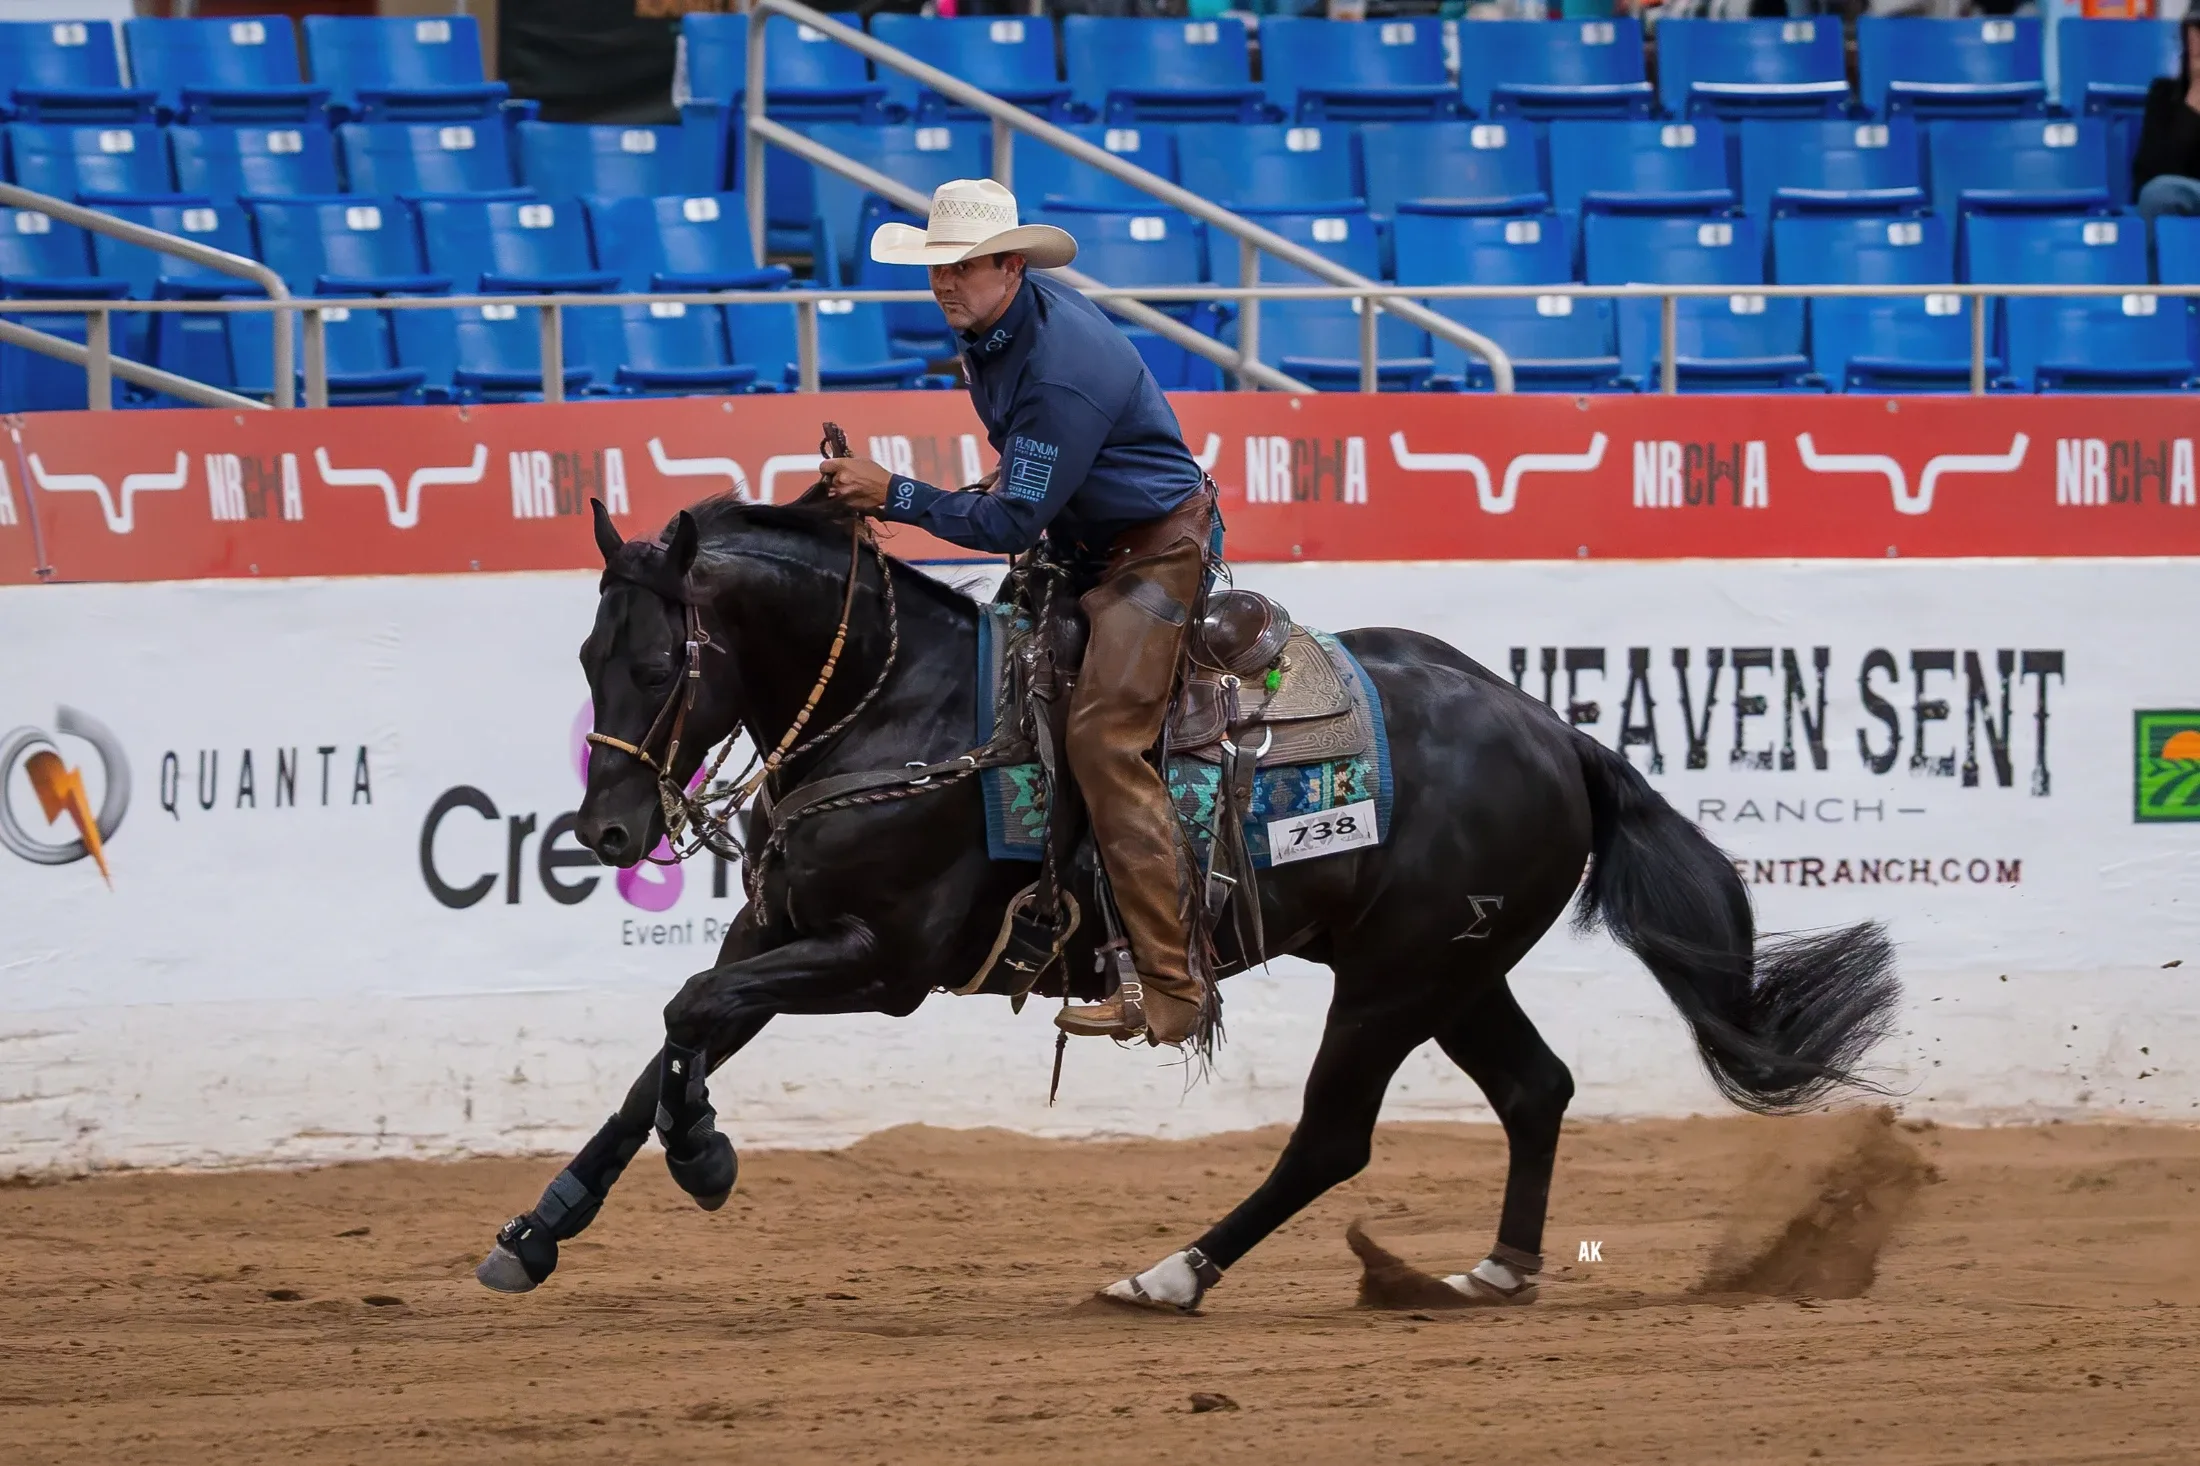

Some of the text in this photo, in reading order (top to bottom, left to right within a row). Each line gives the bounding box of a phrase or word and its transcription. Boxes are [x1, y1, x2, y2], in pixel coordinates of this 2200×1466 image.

[1015, 436, 1059, 458] PLATINUM
[1246, 435, 1368, 504] NRCHA
[1633, 440, 1768, 508] NRCHA
[2056, 438, 2197, 506] NRCHA
[205, 452, 303, 521] NRCHA
[509, 448, 630, 519] NRCHA
[1856, 647, 2065, 797] SENT
[160, 745, 373, 821] QUANTA
[1697, 798, 1884, 823] RANCH
[1288, 816, 1357, 846] 738
[622, 918, 693, 945] Event
